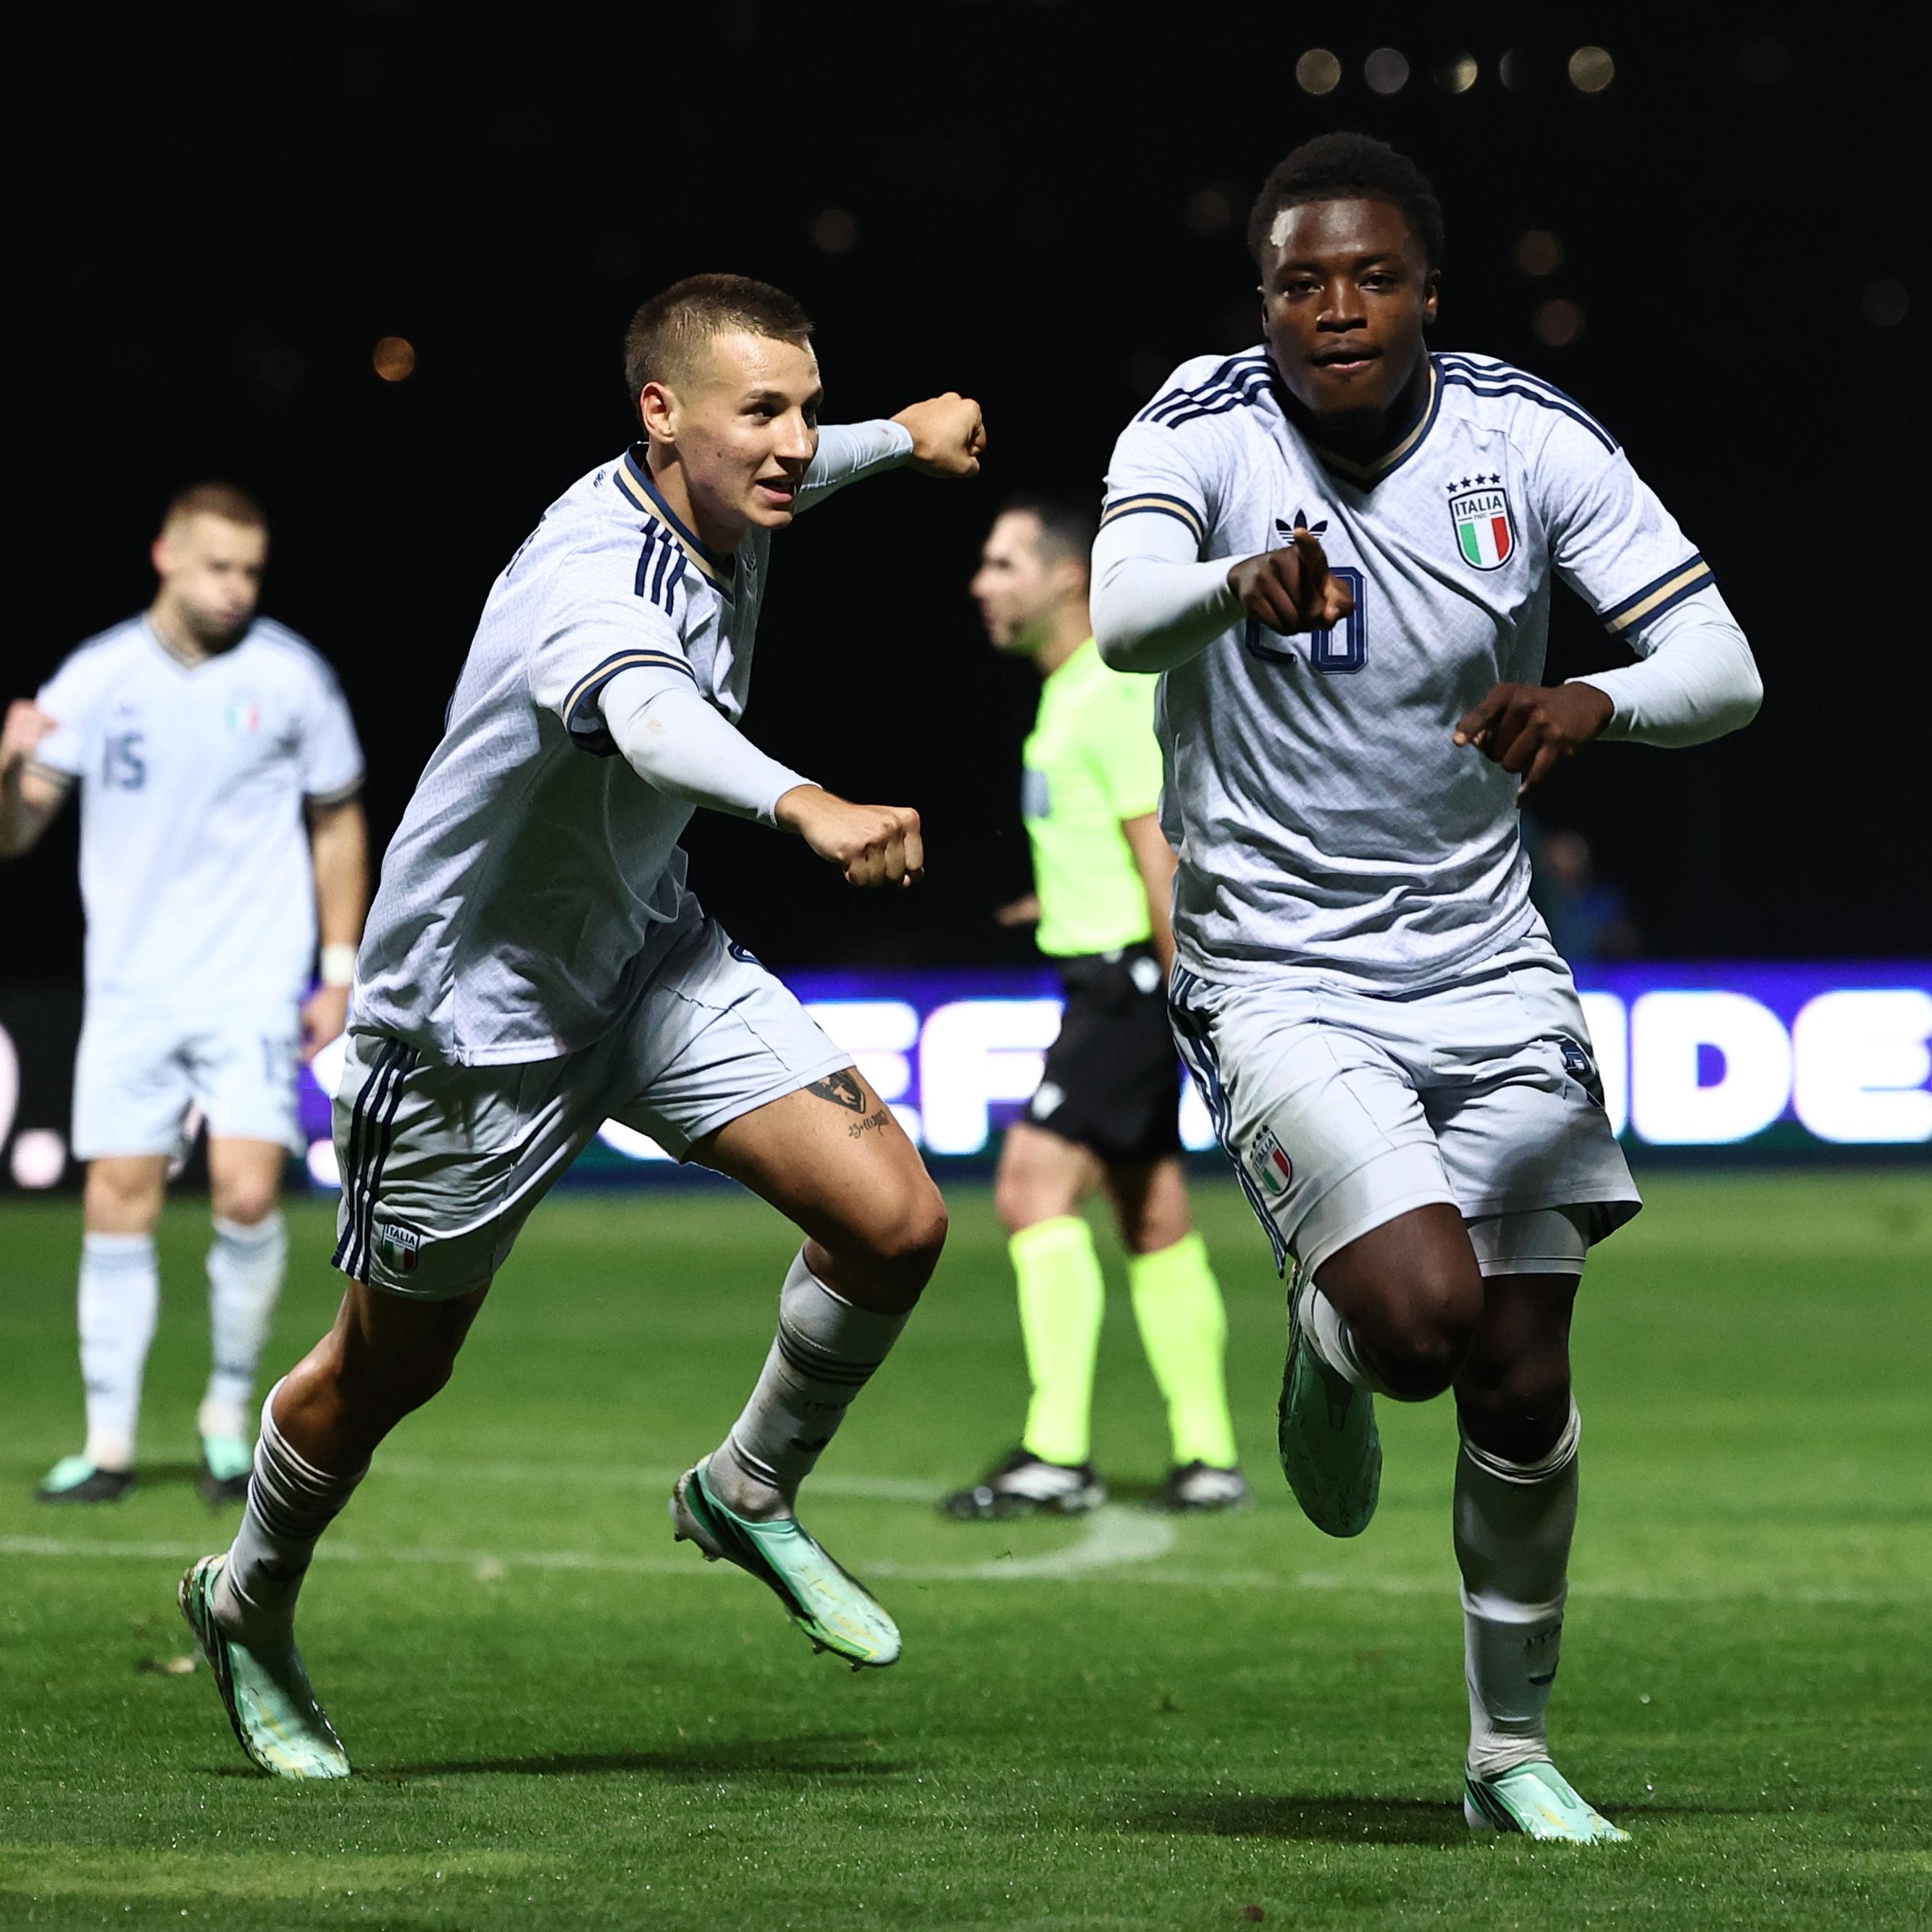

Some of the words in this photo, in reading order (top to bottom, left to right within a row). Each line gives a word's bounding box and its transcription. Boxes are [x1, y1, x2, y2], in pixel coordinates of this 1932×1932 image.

[1454, 495, 1503, 517] ITALIA
[102, 731, 146, 792] 15
[385, 1224, 416, 1246] ITALIA
